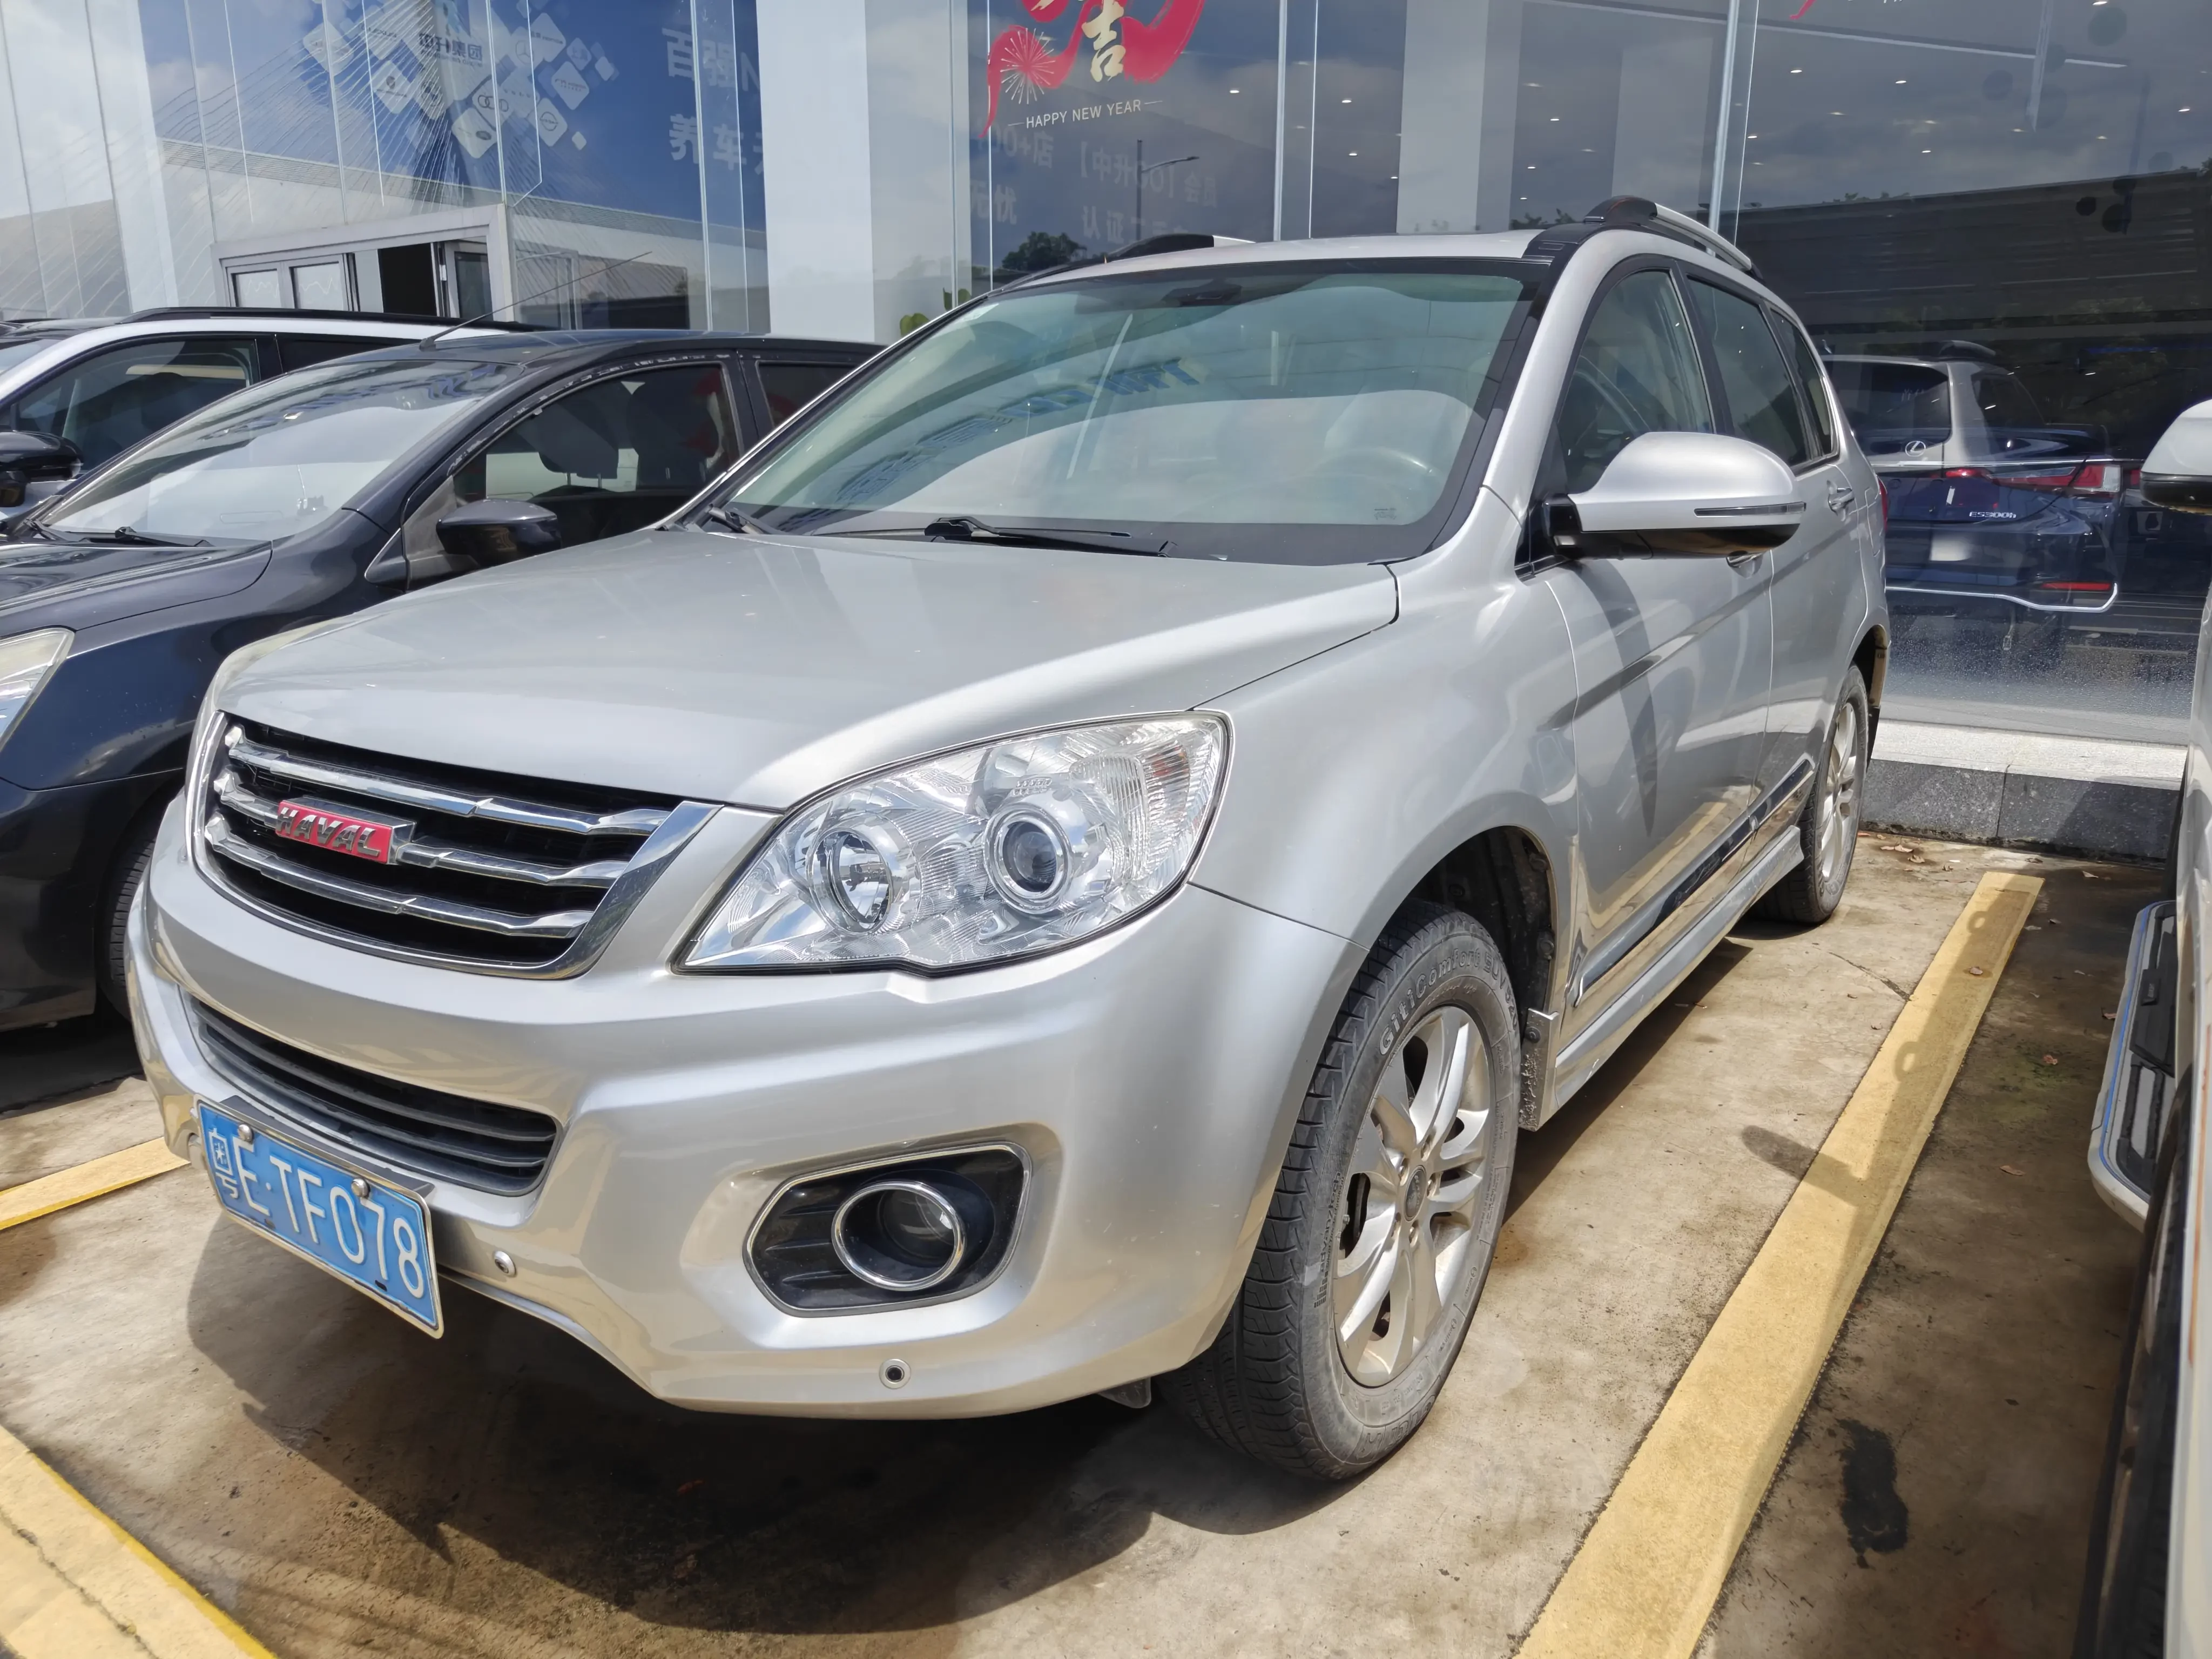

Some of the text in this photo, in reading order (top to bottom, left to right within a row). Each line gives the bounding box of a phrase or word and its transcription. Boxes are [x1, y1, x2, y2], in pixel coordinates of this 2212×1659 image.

[1026, 99, 1142, 129] HAPPY NEW YEAR
[276, 807, 381, 858] HAVAL
[1379, 947, 1480, 1055] GitiComfort
[1484, 951, 1506, 990] SUV
